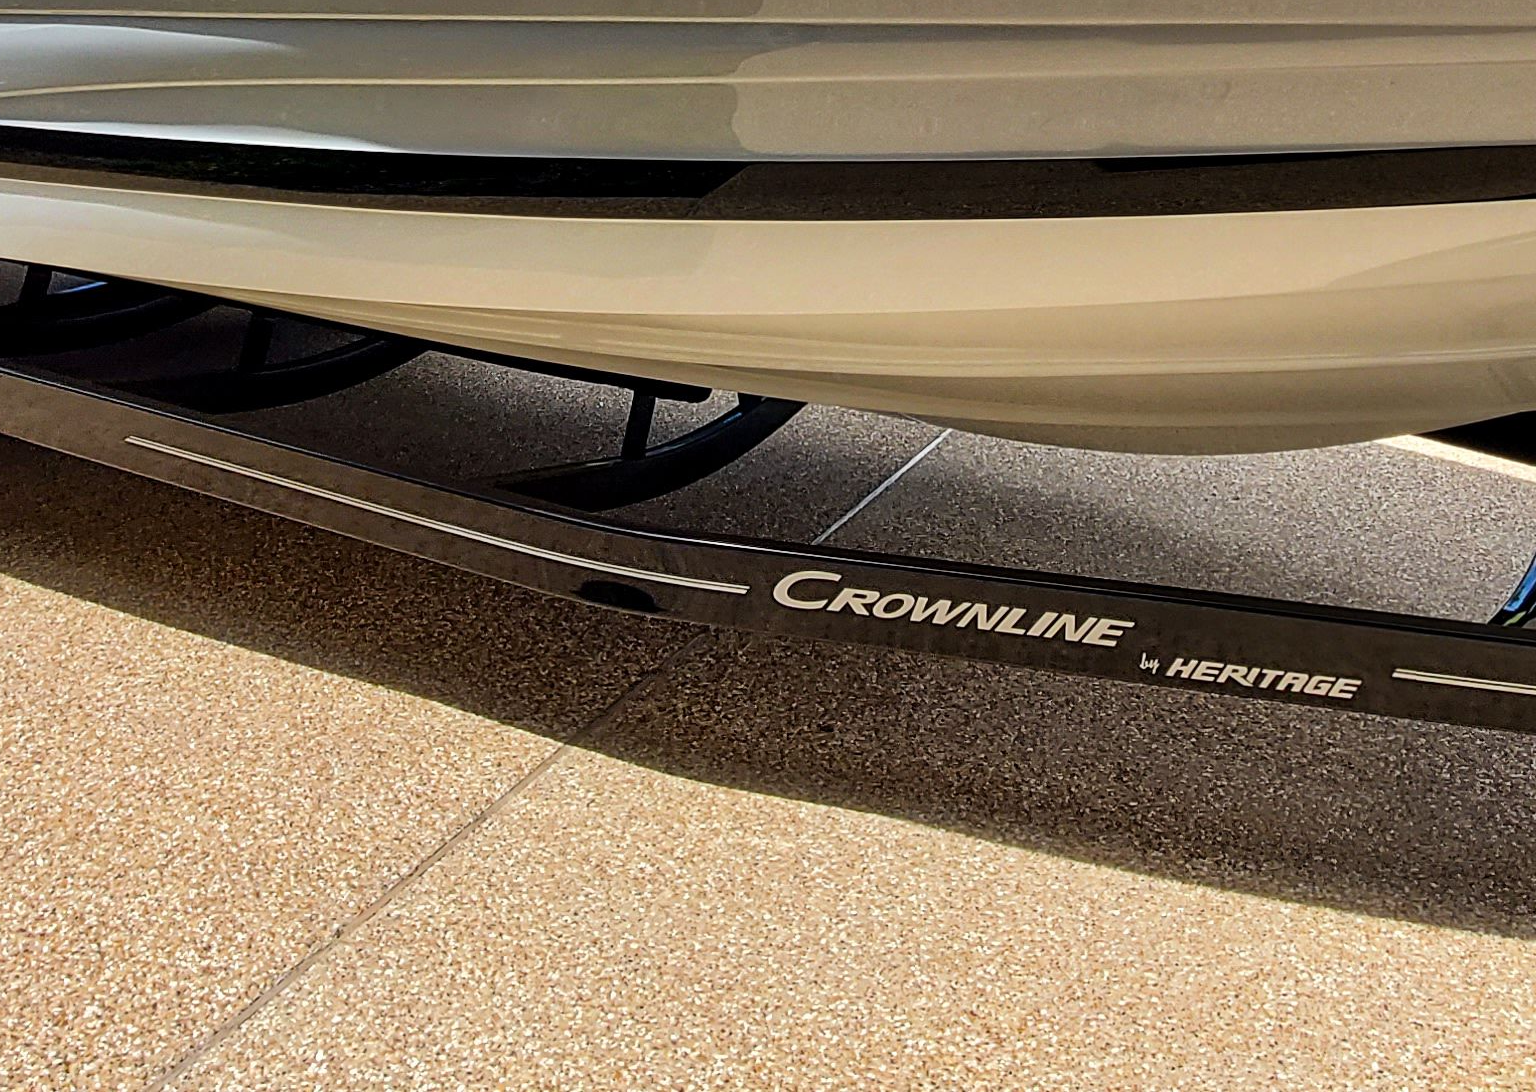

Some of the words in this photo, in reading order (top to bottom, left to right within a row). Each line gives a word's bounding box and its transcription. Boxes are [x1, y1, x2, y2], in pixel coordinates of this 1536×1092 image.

[772, 570, 1135, 648] CROWNLINE
[1139, 652, 1160, 675] by
[1164, 657, 1362, 700] HERITAGE
